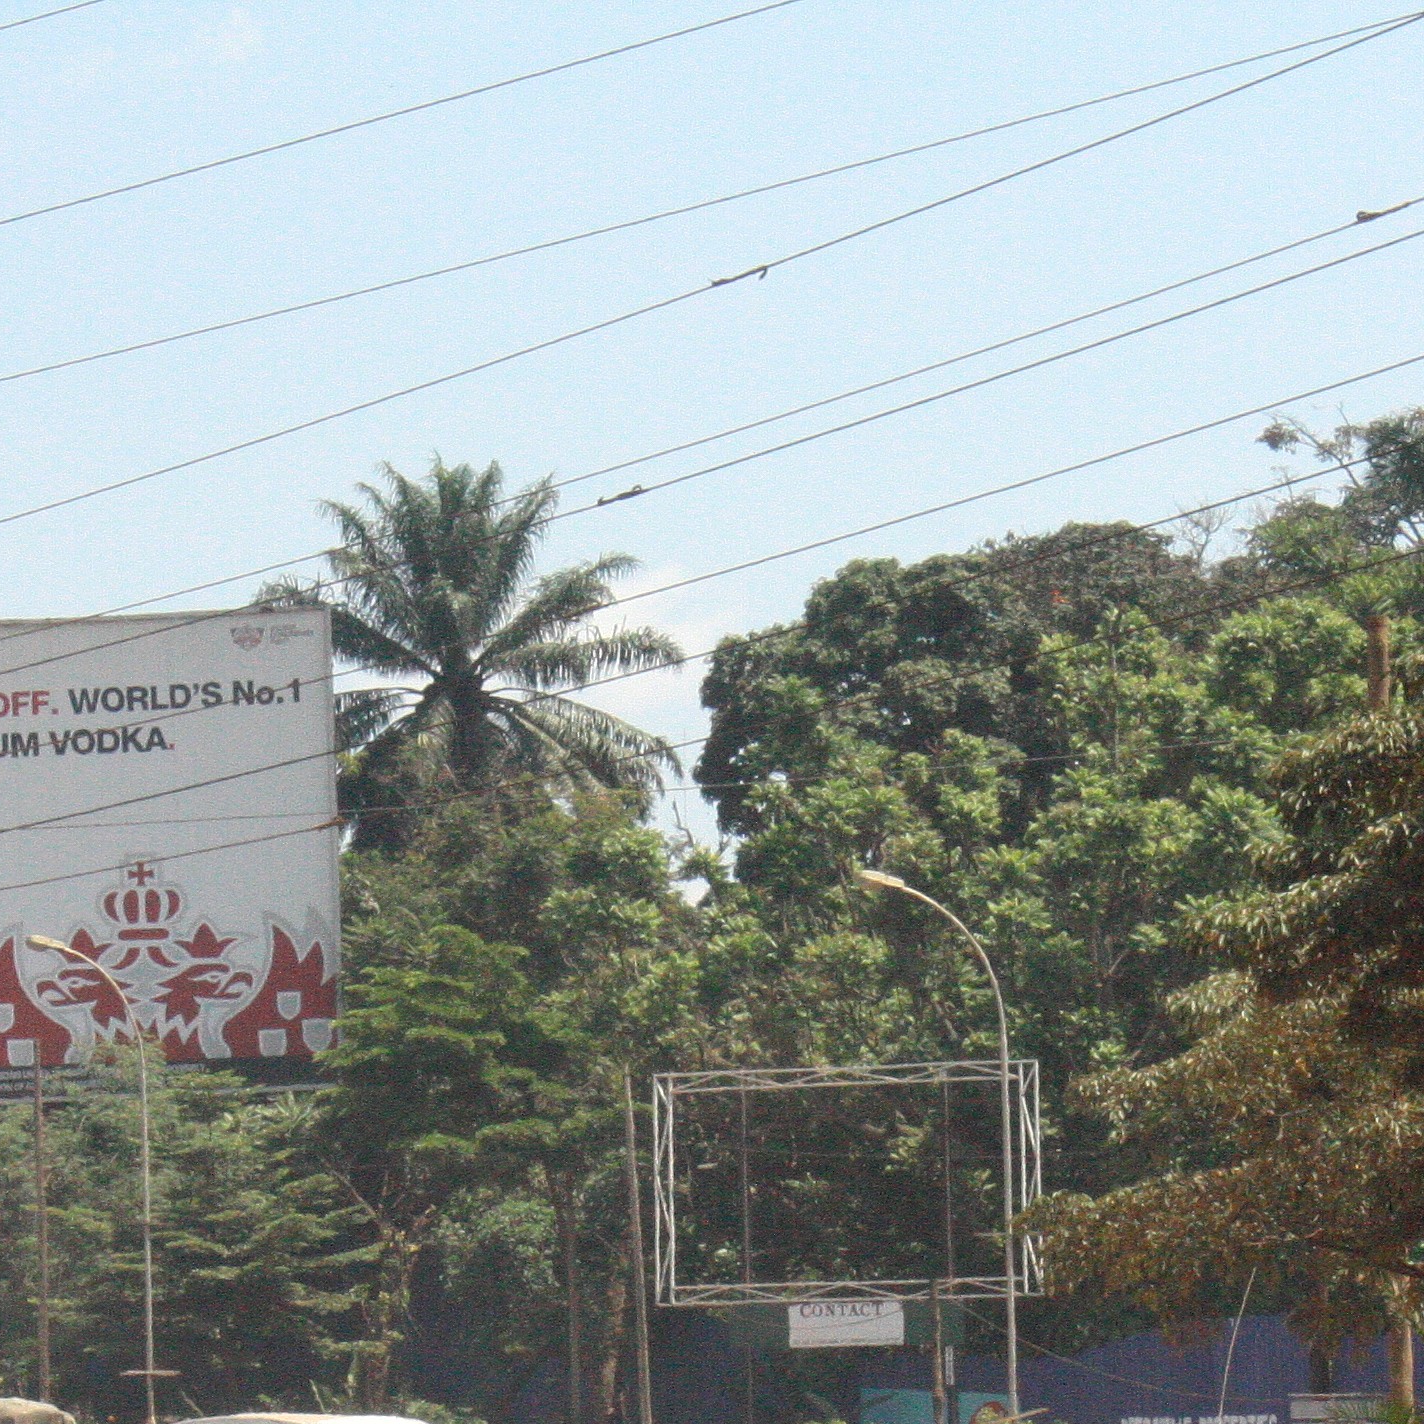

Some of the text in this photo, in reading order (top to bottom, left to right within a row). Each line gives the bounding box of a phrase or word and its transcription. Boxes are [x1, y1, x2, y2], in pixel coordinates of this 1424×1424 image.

[68, 682, 223, 715] WORLD'S
[49, 727, 176, 756] VODKA.
[799, 1302, 884, 1318] CONTACT
